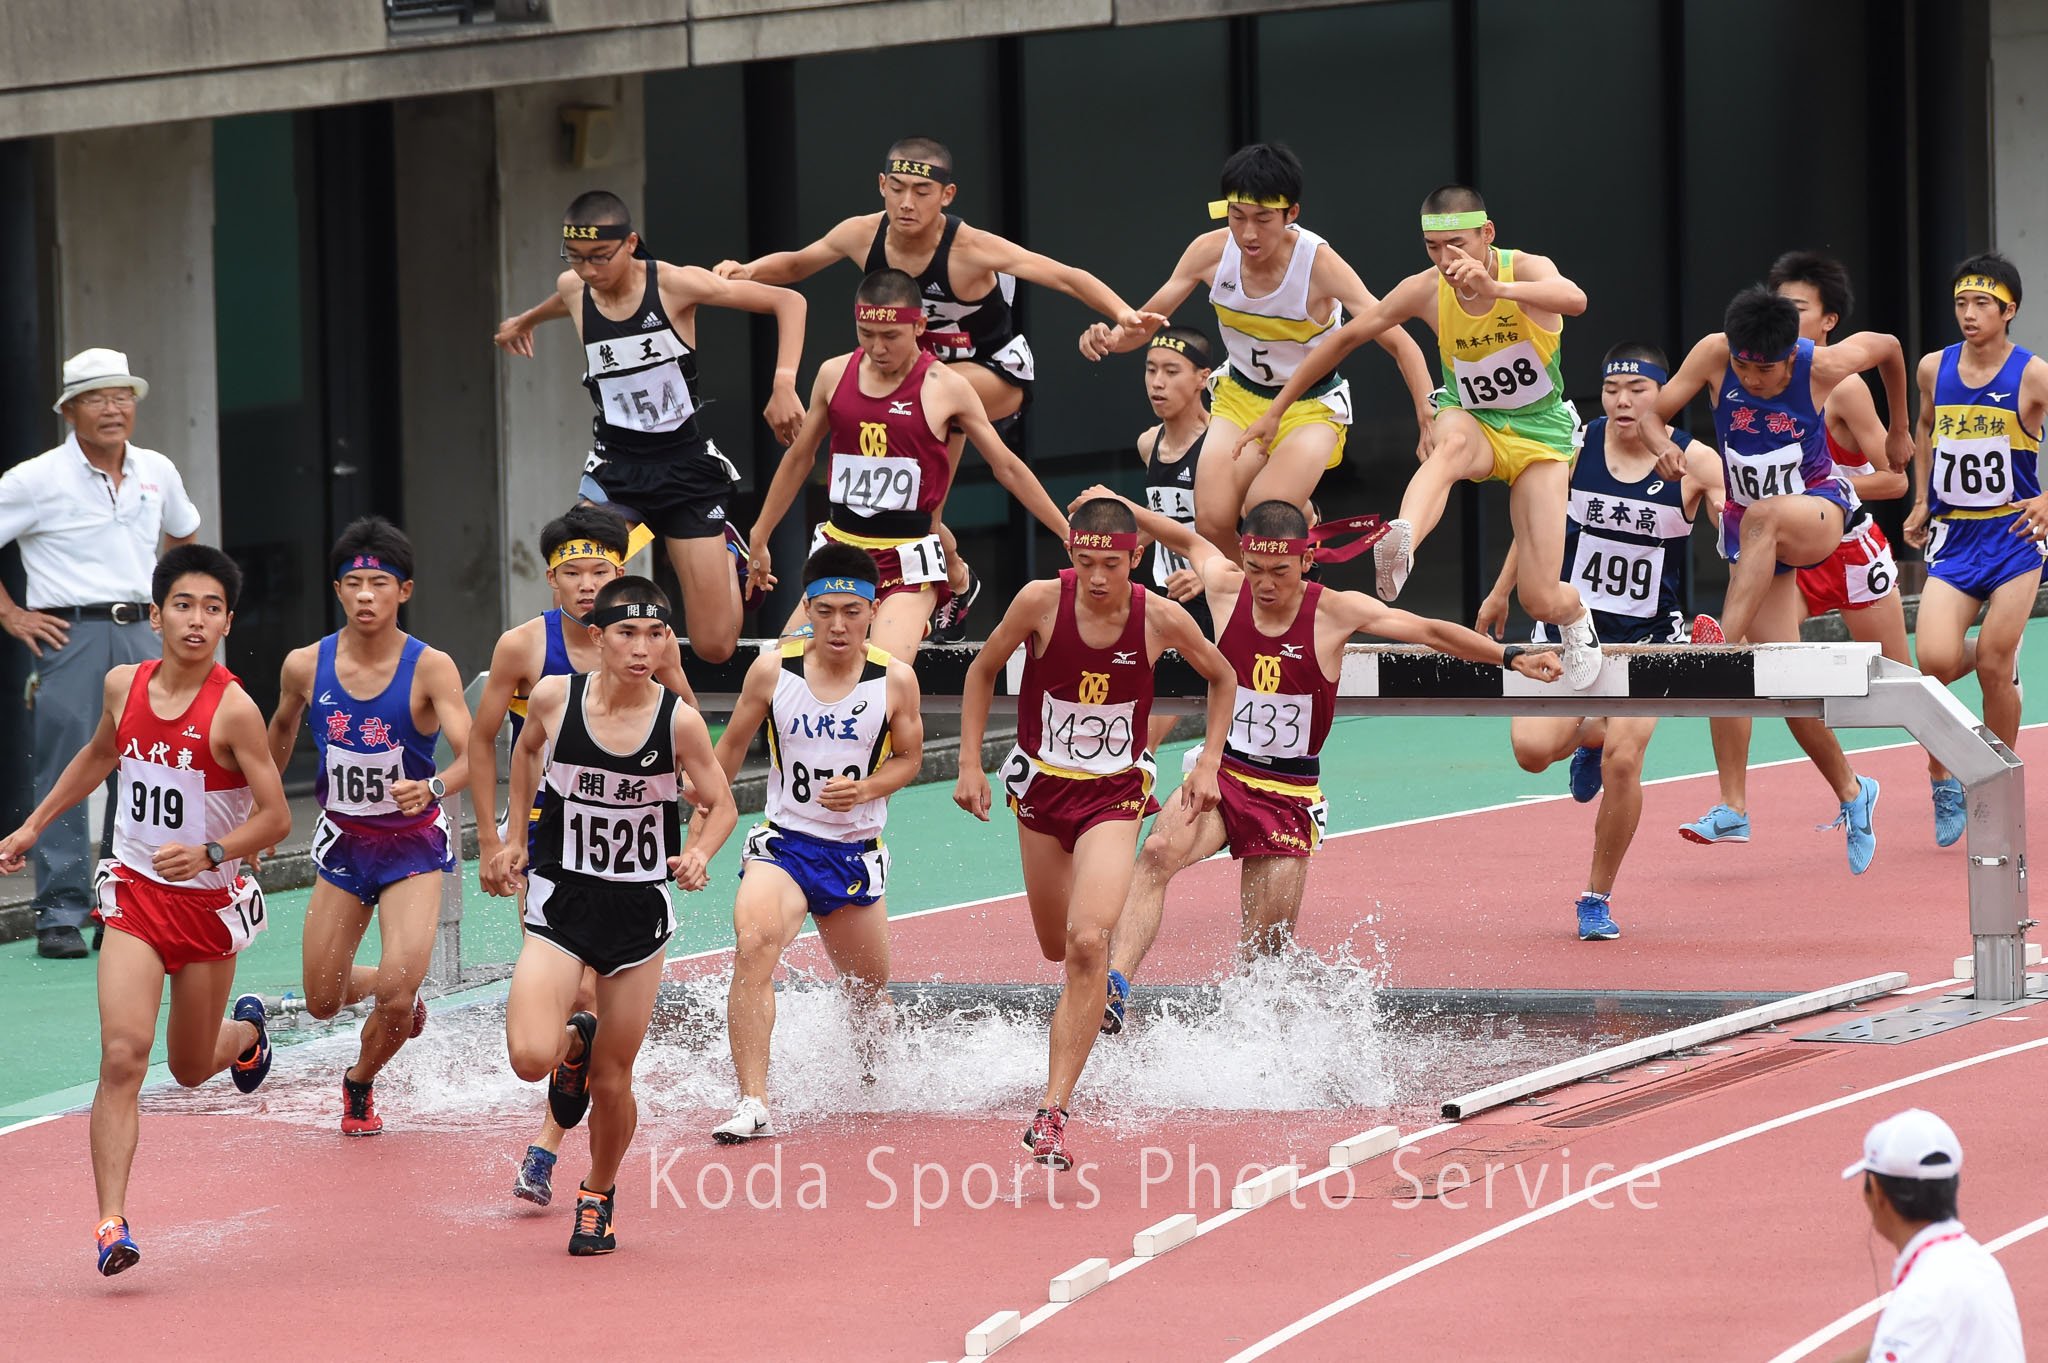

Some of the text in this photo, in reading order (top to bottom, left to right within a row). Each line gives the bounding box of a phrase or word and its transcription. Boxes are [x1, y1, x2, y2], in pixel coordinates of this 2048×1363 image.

[859, 308, 897, 321] 九州学院
[1456, 331, 1519, 350] 熊本千原台
[1251, 348, 1274, 382] 5
[1461, 358, 1538, 404] 1398
[1730, 407, 1805, 438] 慶誠
[1939, 415, 2005, 436] 宇土高校
[838, 467, 913, 512] 1429
[1731, 462, 1797, 500] 1647
[1940, 451, 2005, 495] 763
[1586, 498, 1657, 533] 鹿本高
[1073, 532, 1113, 548] 九州学院
[1249, 539, 1289, 554] 九州学院
[914, 543, 947, 576] 15
[1582, 551, 1652, 601] 499
[1867, 561, 1889, 594] 6
[627, 604, 658, 617] 開新
[326, 711, 400, 750] 慶誠
[1048, 701, 1131, 760] 1430
[123, 737, 196, 771] 八代東
[578, 772, 648, 802] 開新
[131, 781, 184, 829] 919
[570, 812, 658, 874] 1526
[234, 890, 264, 938] 10
